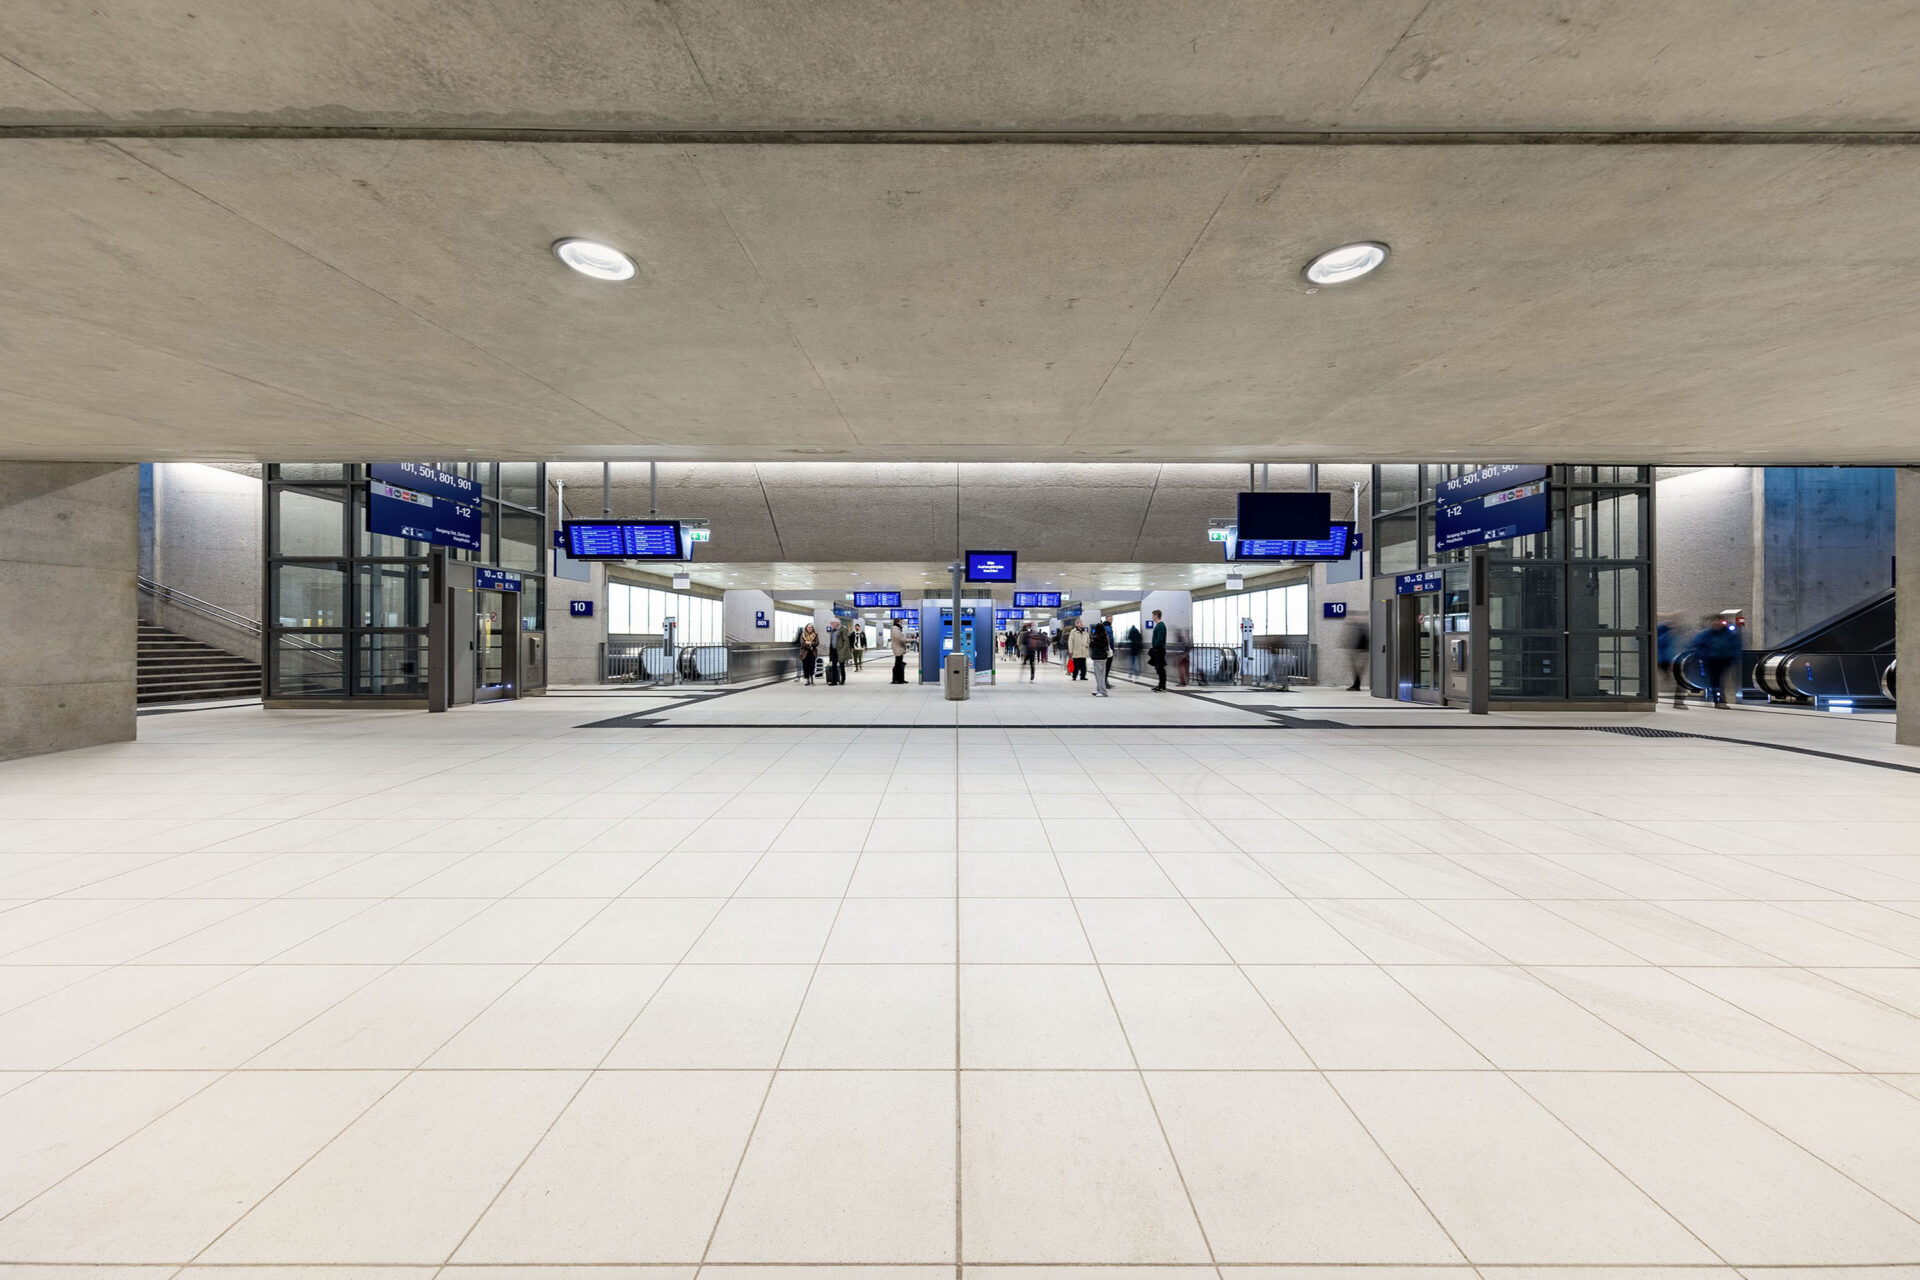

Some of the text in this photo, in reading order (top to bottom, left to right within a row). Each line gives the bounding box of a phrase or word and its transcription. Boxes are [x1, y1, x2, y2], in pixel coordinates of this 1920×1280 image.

[420, 466, 437, 481] 501,
[439, 472, 456, 487] 801,
[458, 479, 471, 490] 901
[1447, 479, 1461, 490] 101,
[1463, 473, 1479, 485] 501,
[1482, 467, 1499, 479] 801,
[456, 506, 470, 518] 1-12
[1446, 506, 1462, 517] 1-12
[484, 570, 491, 578] 10
[573, 602, 585, 611] 10
[1331, 604, 1344, 613] 10
